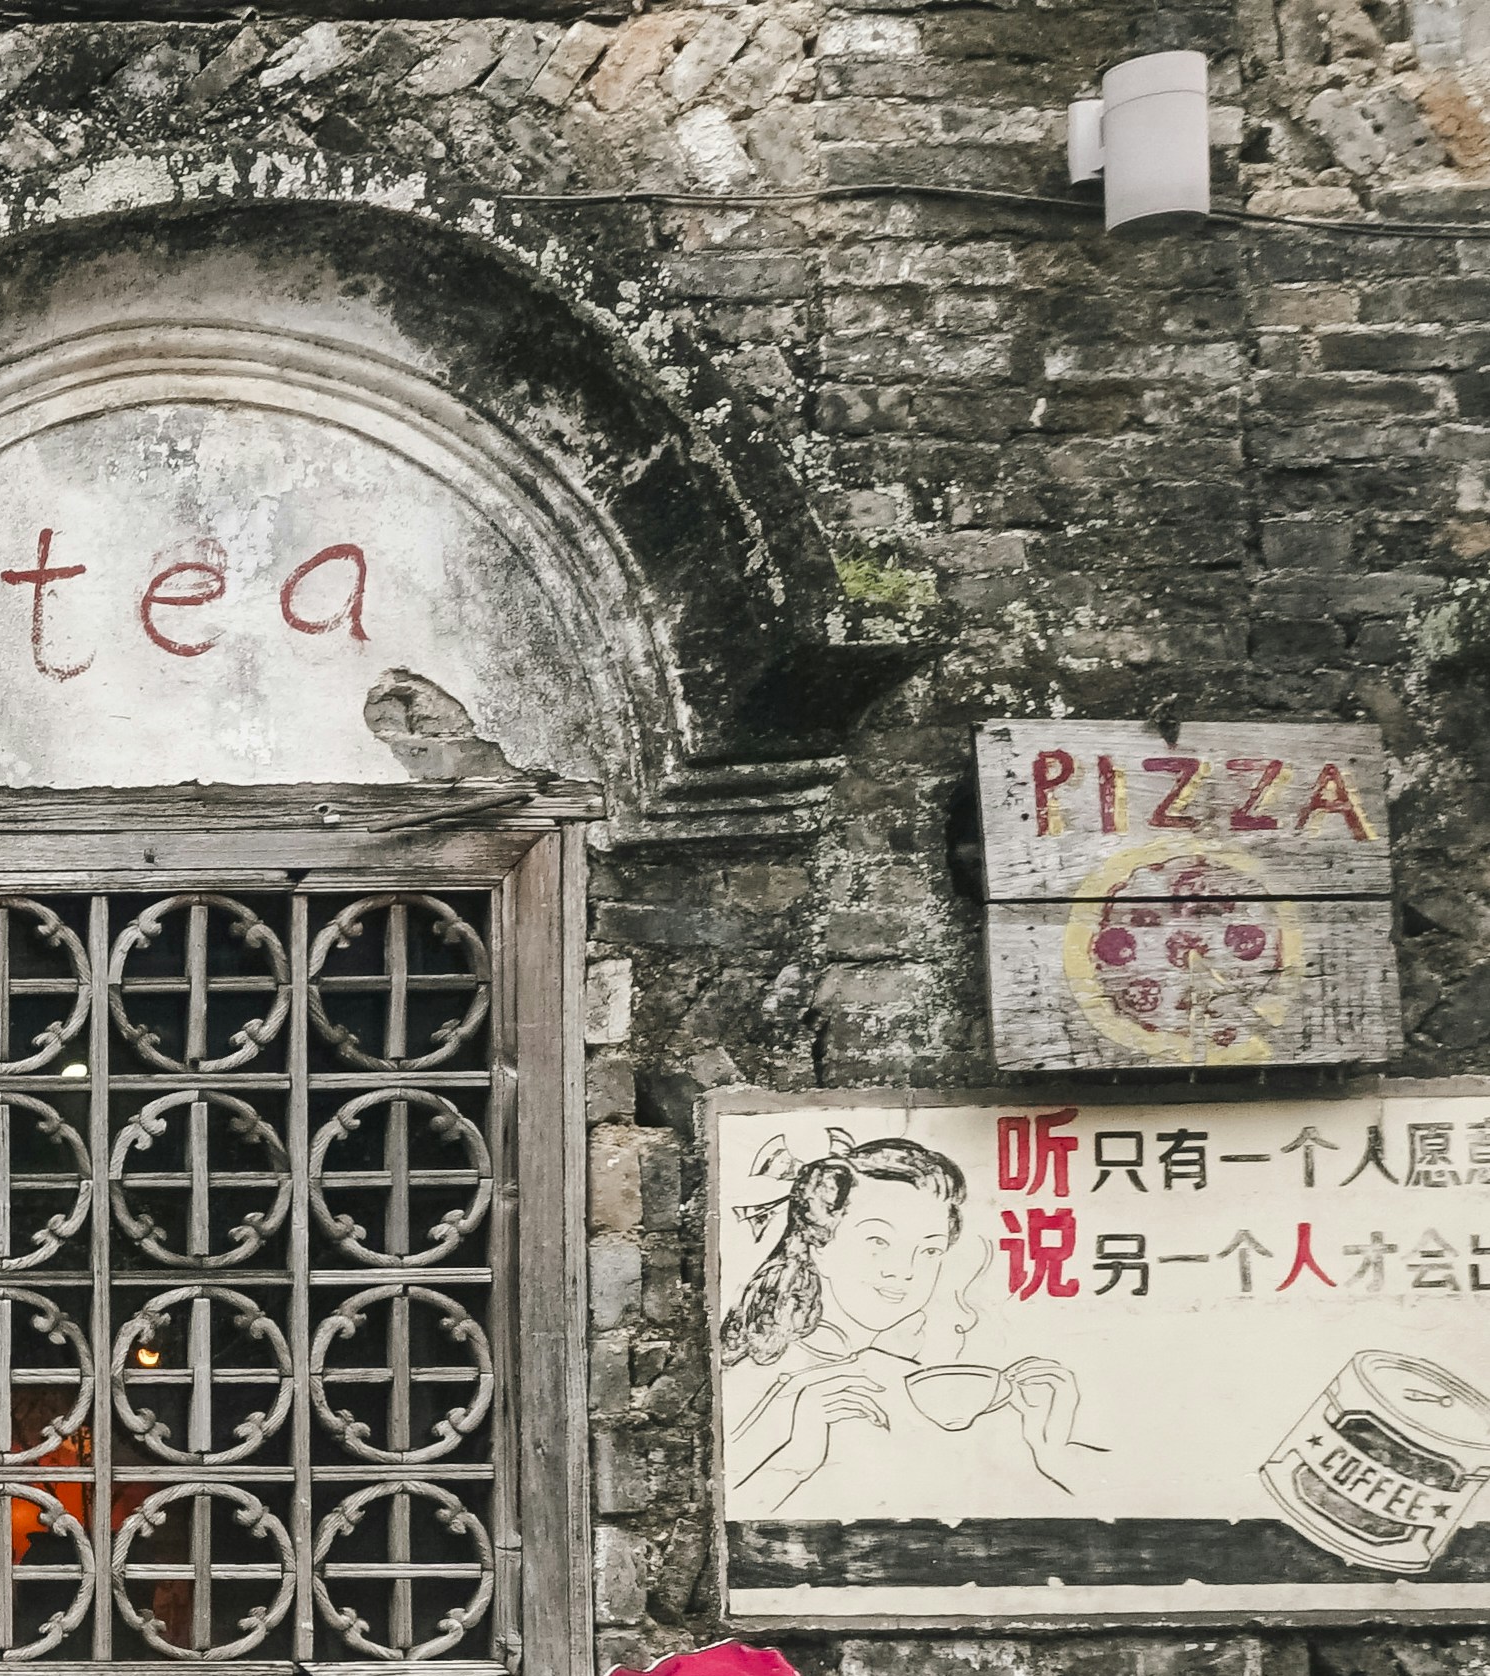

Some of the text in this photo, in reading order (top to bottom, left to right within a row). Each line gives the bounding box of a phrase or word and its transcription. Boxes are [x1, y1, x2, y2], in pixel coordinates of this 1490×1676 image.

[0, 528, 371, 682] tea
[1032, 748, 1376, 842] PIZZA
[1318, 1445, 1430, 1521] COFFEE
